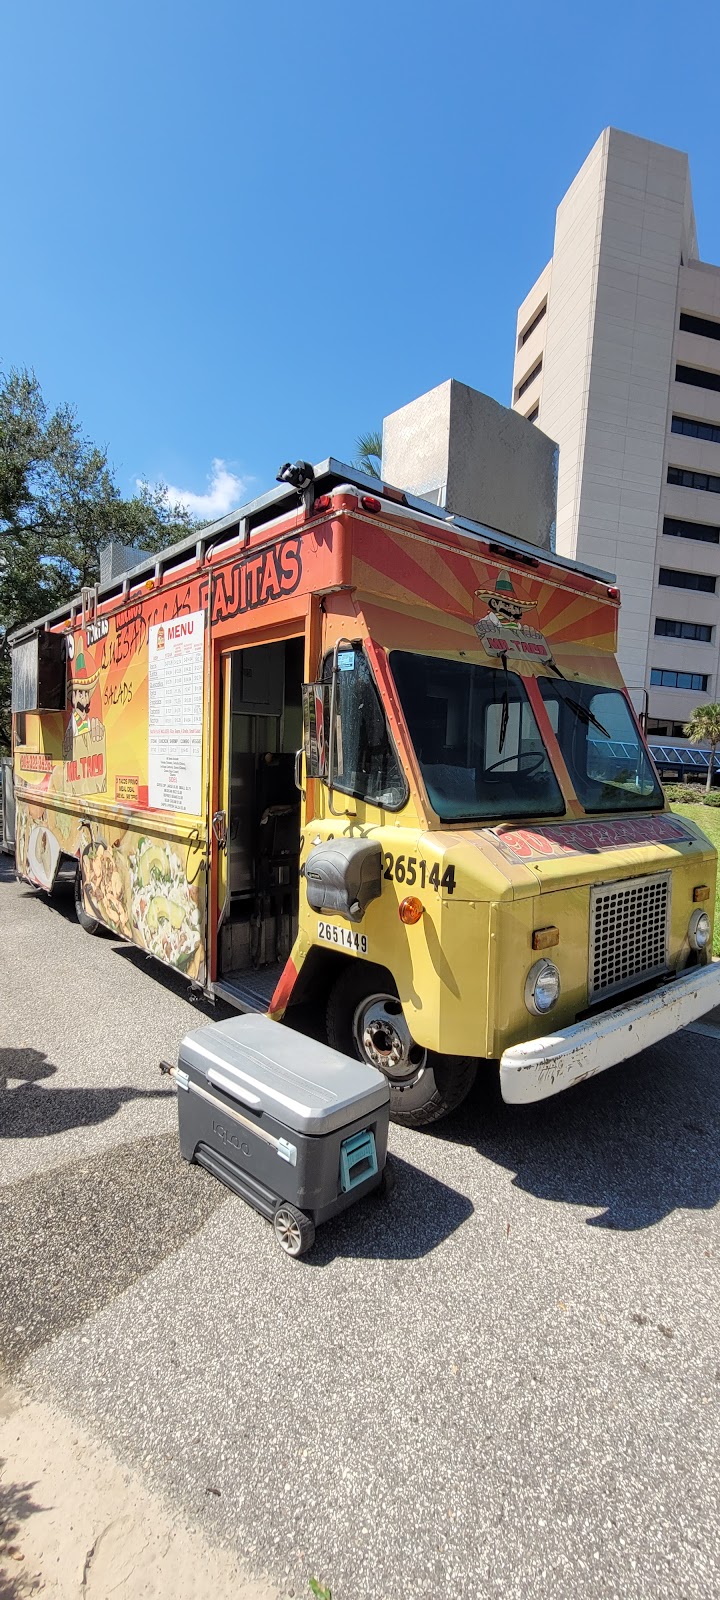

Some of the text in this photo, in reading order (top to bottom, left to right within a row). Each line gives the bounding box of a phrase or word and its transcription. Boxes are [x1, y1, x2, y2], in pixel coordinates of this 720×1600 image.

[199, 538, 302, 628] FAJITAS
[167, 620, 194, 640] MENU
[510, 639, 548, 656] TACO
[104, 681, 133, 706] SALADS
[80, 753, 104, 778] TACO
[318, 922, 367, 953] 2651449
